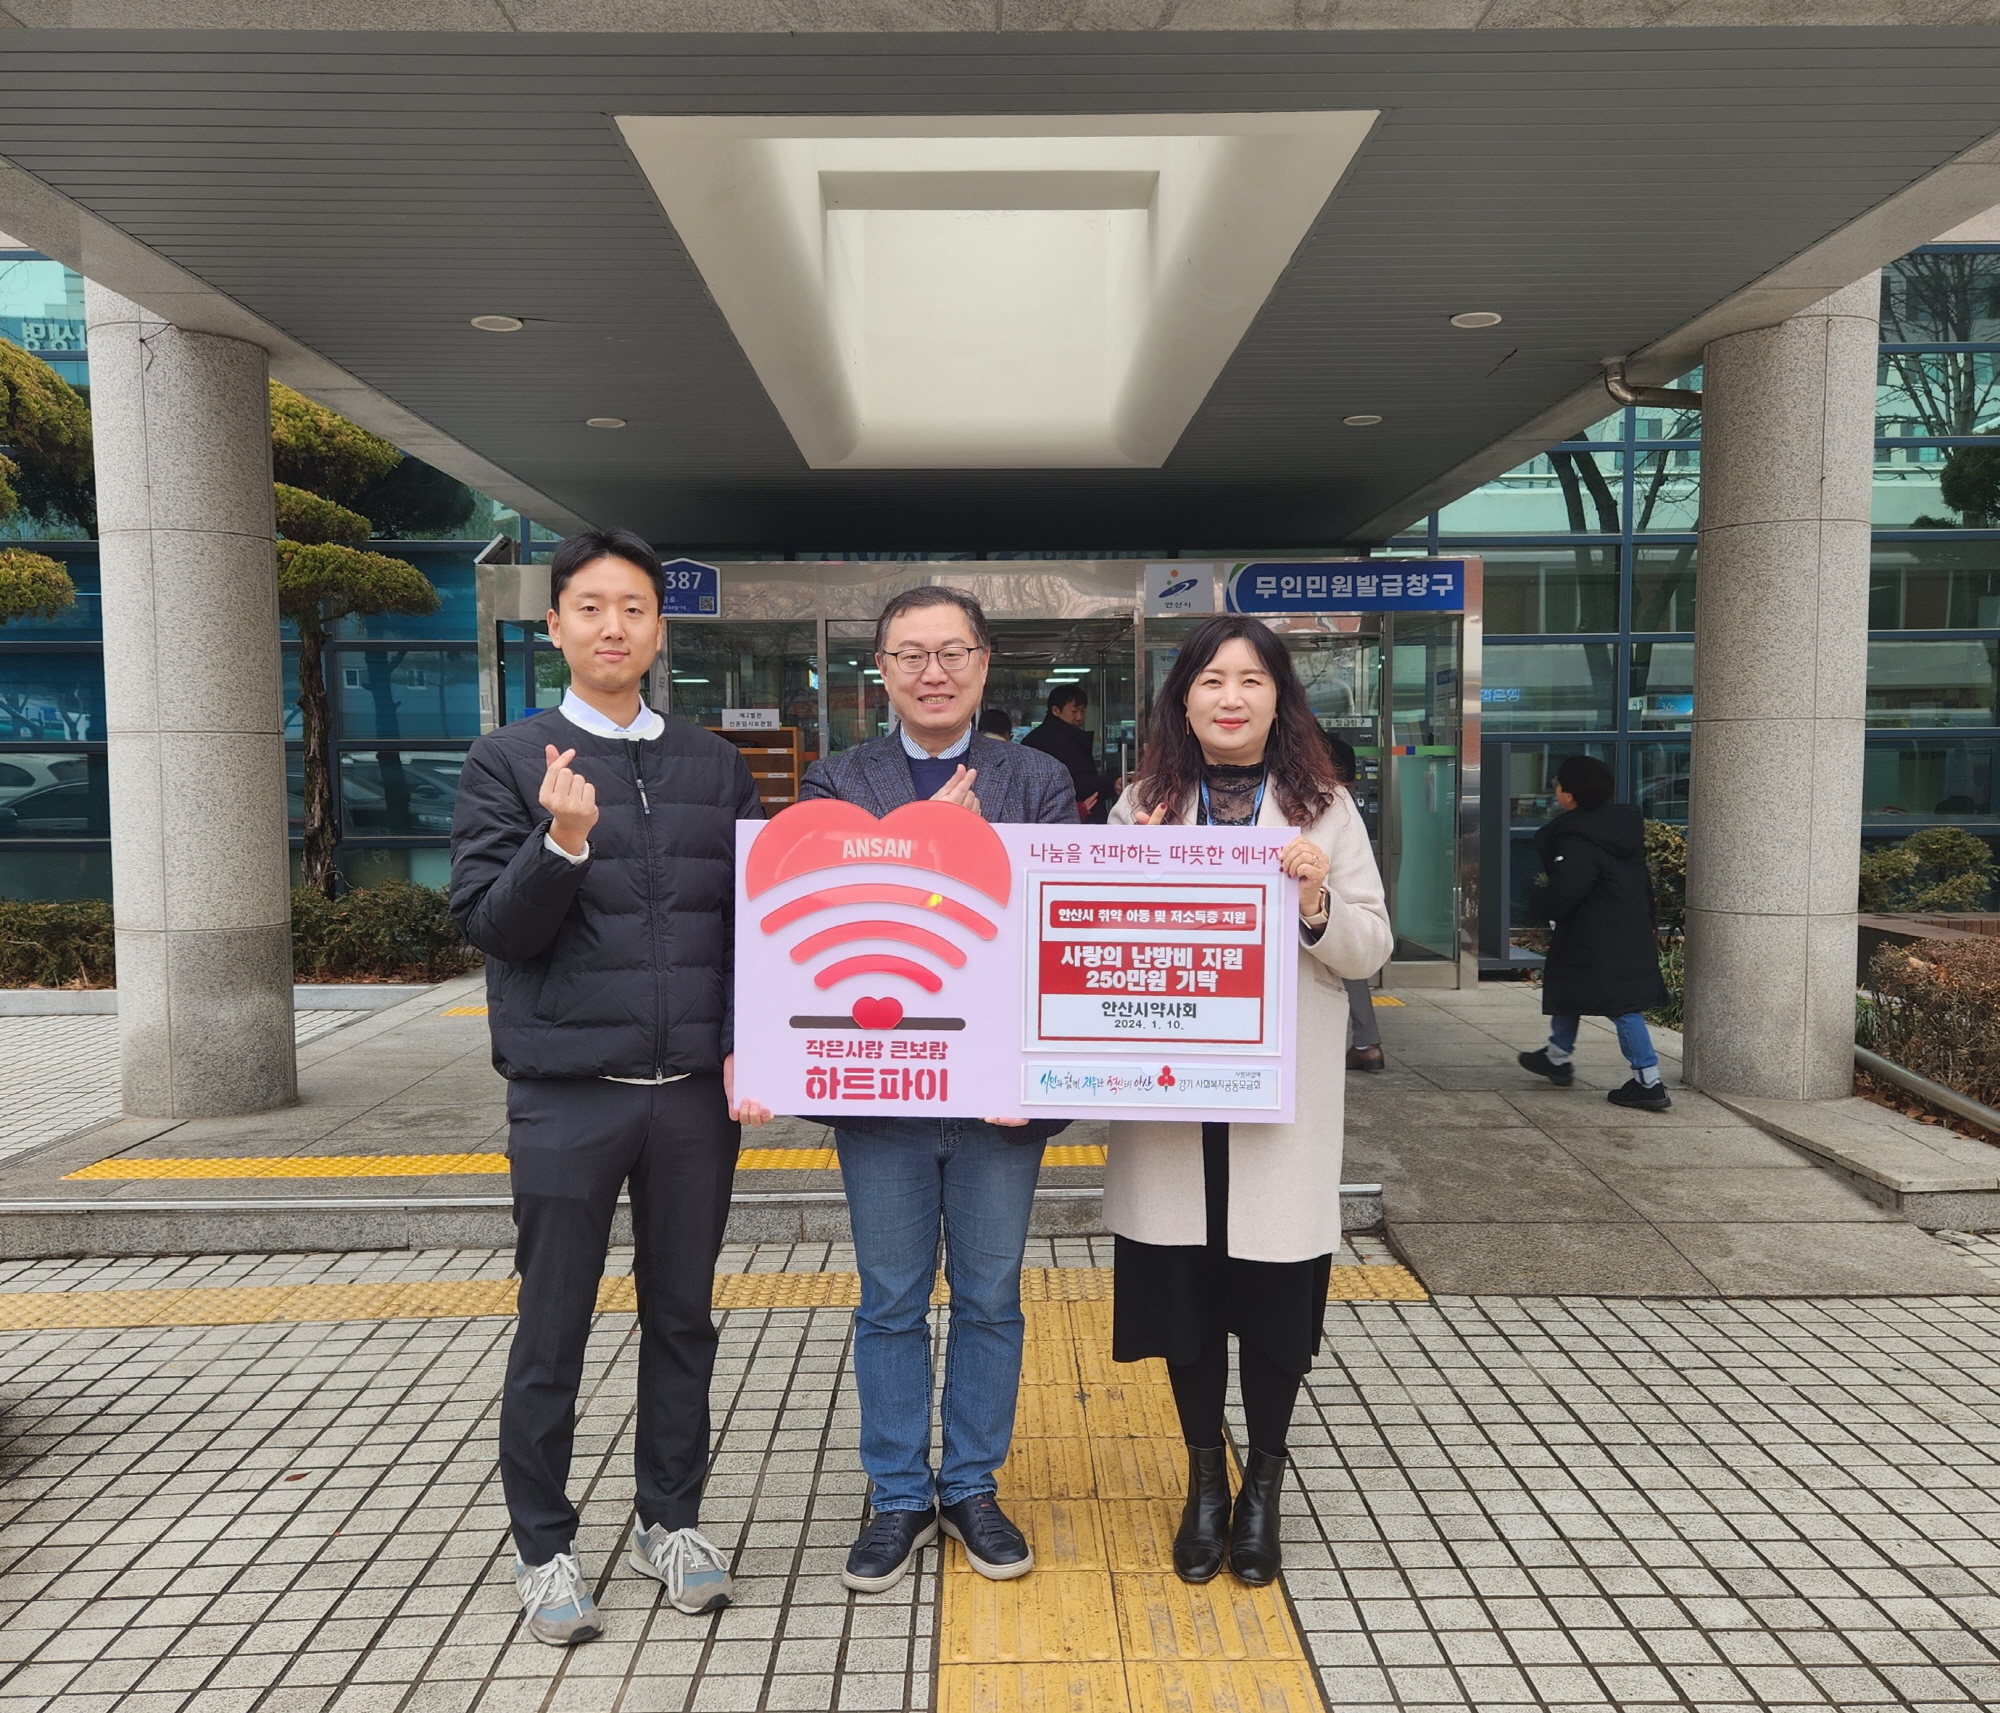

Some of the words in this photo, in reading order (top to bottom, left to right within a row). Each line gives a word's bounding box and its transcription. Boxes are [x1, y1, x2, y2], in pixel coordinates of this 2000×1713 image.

[665, 571, 702, 590] 387
[1255, 573, 1454, 599] 무인민원발급창구
[1165, 601, 1191, 609] 안산시
[1336, 719, 1366, 727] 발급창구
[842, 838, 912, 859] ANSAN
[1031, 843, 1082, 864] 나눔을
[1089, 844, 1162, 865] 전파하는
[1170, 845, 1225, 866] 따뜻한
[1058, 908, 1094, 923] 안산시
[1098, 909, 1123, 923] 취약
[1126, 909, 1150, 923] 아동
[1154, 909, 1167, 923] 및
[1170, 910, 1219, 924] 저소득층
[1222, 911, 1246, 925] 지원
[1060, 945, 1122, 968] 사랑의
[1131, 947, 1193, 969] 난방비
[1201, 947, 1243, 970] 지원
[1085, 970, 1167, 992] 250만원
[1176, 971, 1218, 993] 기탁
[1101, 1001, 1197, 1019] 안산시약사회
[1114, 1019, 1146, 1030] 2024.
[1151, 1020, 1162, 1030] 1.
[1167, 1020, 1185, 1031] 10.
[806, 1040, 884, 1059] 작은사랑
[890, 1040, 948, 1060] 큰보람
[805, 1065, 949, 1102] 하트파이
[1133, 1075, 1155, 1092] 안산
[1179, 1080, 1194, 1092] 경기
[1195, 1080, 1261, 1093] 사회복지공동모금회
